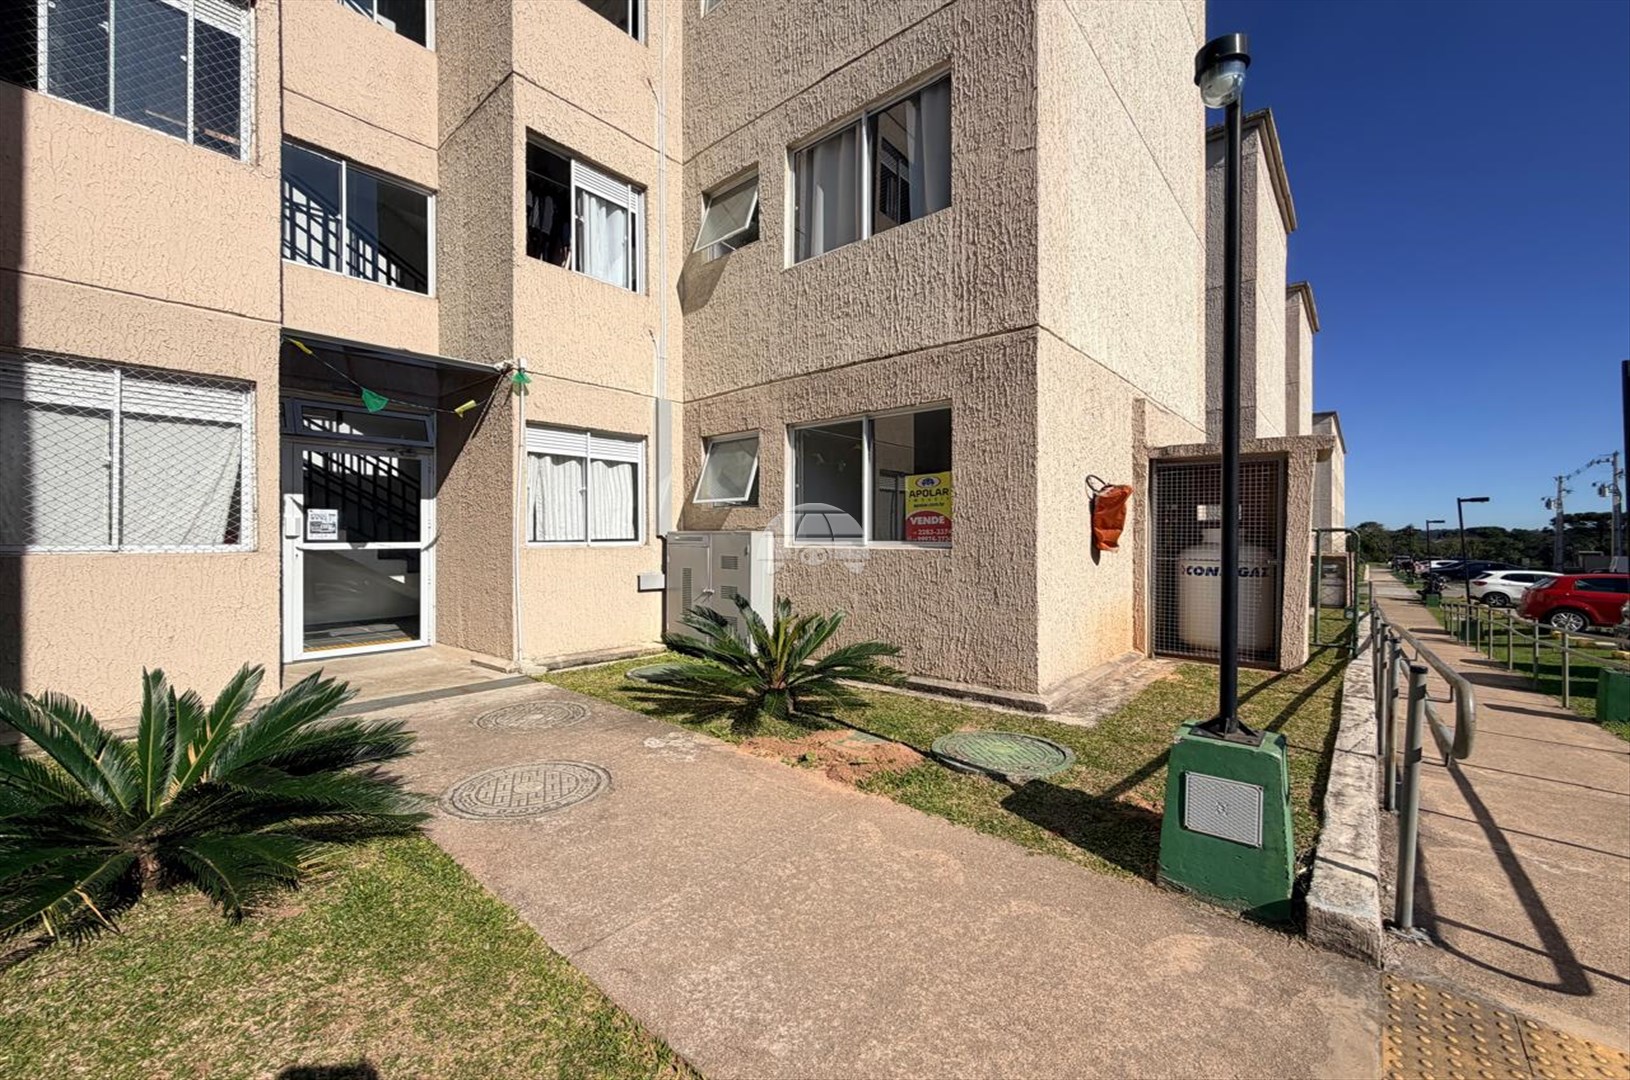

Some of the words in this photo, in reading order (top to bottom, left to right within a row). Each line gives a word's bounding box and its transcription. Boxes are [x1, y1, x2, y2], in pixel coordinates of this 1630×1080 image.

[909, 488, 949, 498] APOLAR
[910, 516, 945, 525] VENDE
[1186, 565, 1269, 577] CONGAZ
